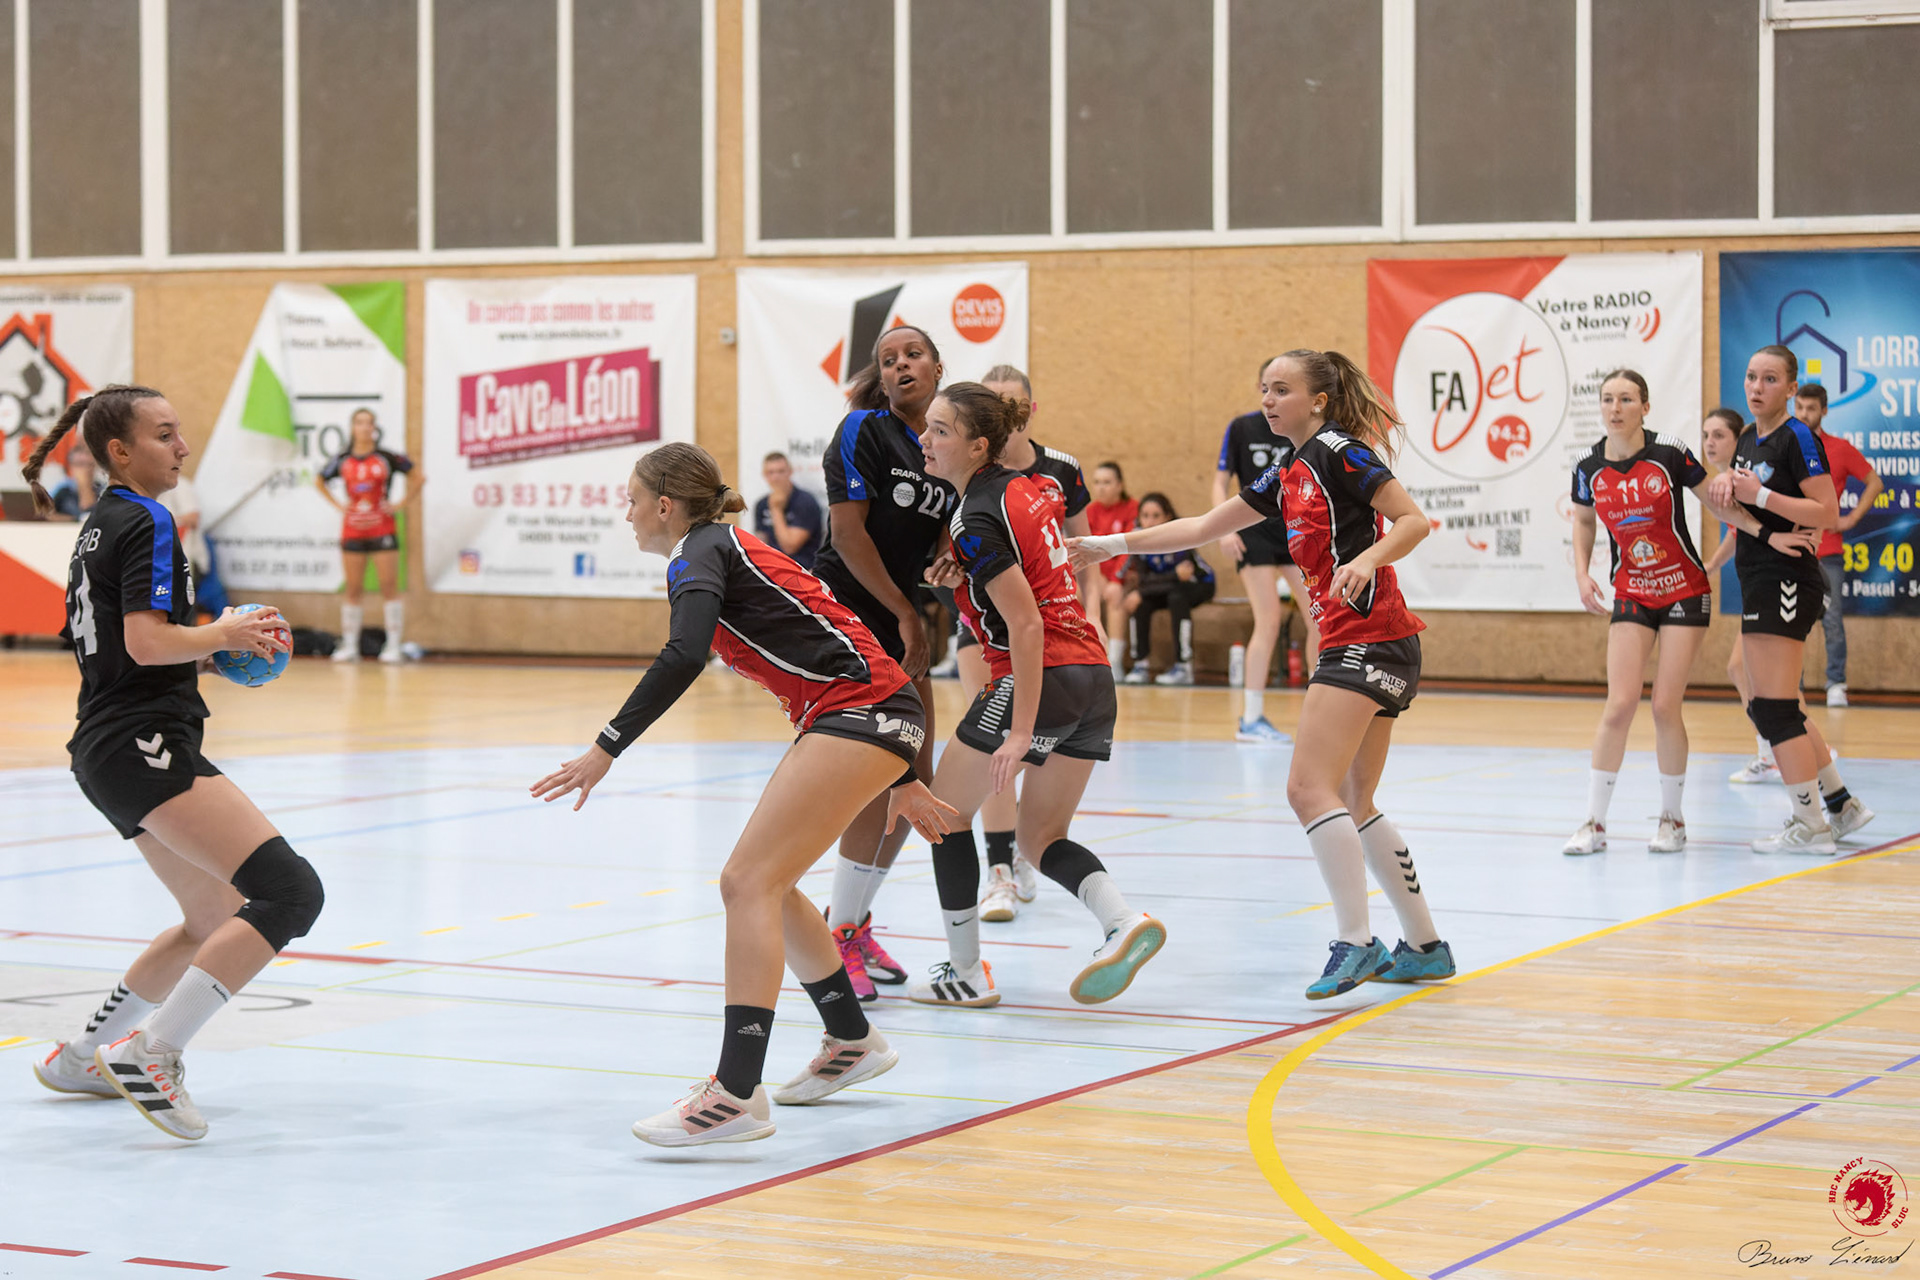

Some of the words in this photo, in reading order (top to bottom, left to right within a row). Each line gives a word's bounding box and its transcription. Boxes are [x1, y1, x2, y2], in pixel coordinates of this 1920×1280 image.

[955, 299, 1003, 314] DEVIS
[1537, 298, 1588, 315] Votre
[1593, 290, 1652, 310] RADIO
[1577, 316, 1631, 330] Nancy
[475, 373, 550, 441] Cave
[566, 355, 641, 427] Léon
[1880, 378, 1920, 417] ST
[1489, 425, 1528, 442] 94.2
[1869, 431, 1920, 451] BOXES
[891, 467, 916, 480] CRAFT
[473, 483, 505, 508] 03
[511, 483, 539, 508] 83
[546, 483, 574, 508] 17
[580, 483, 608, 508] 84
[917, 481, 946, 520] 22
[1617, 477, 1640, 505] 11
[1879, 541, 1914, 573] 40
[1628, 570, 1686, 589] COMPTOIR
[1852, 579, 1896, 597] Pascal
[1379, 681, 1403, 698] SPORT
[1382, 670, 1407, 691] INTER
[902, 720, 925, 740] INTE
[1031, 735, 1058, 744] NTER
[1030, 742, 1055, 754] PORT
